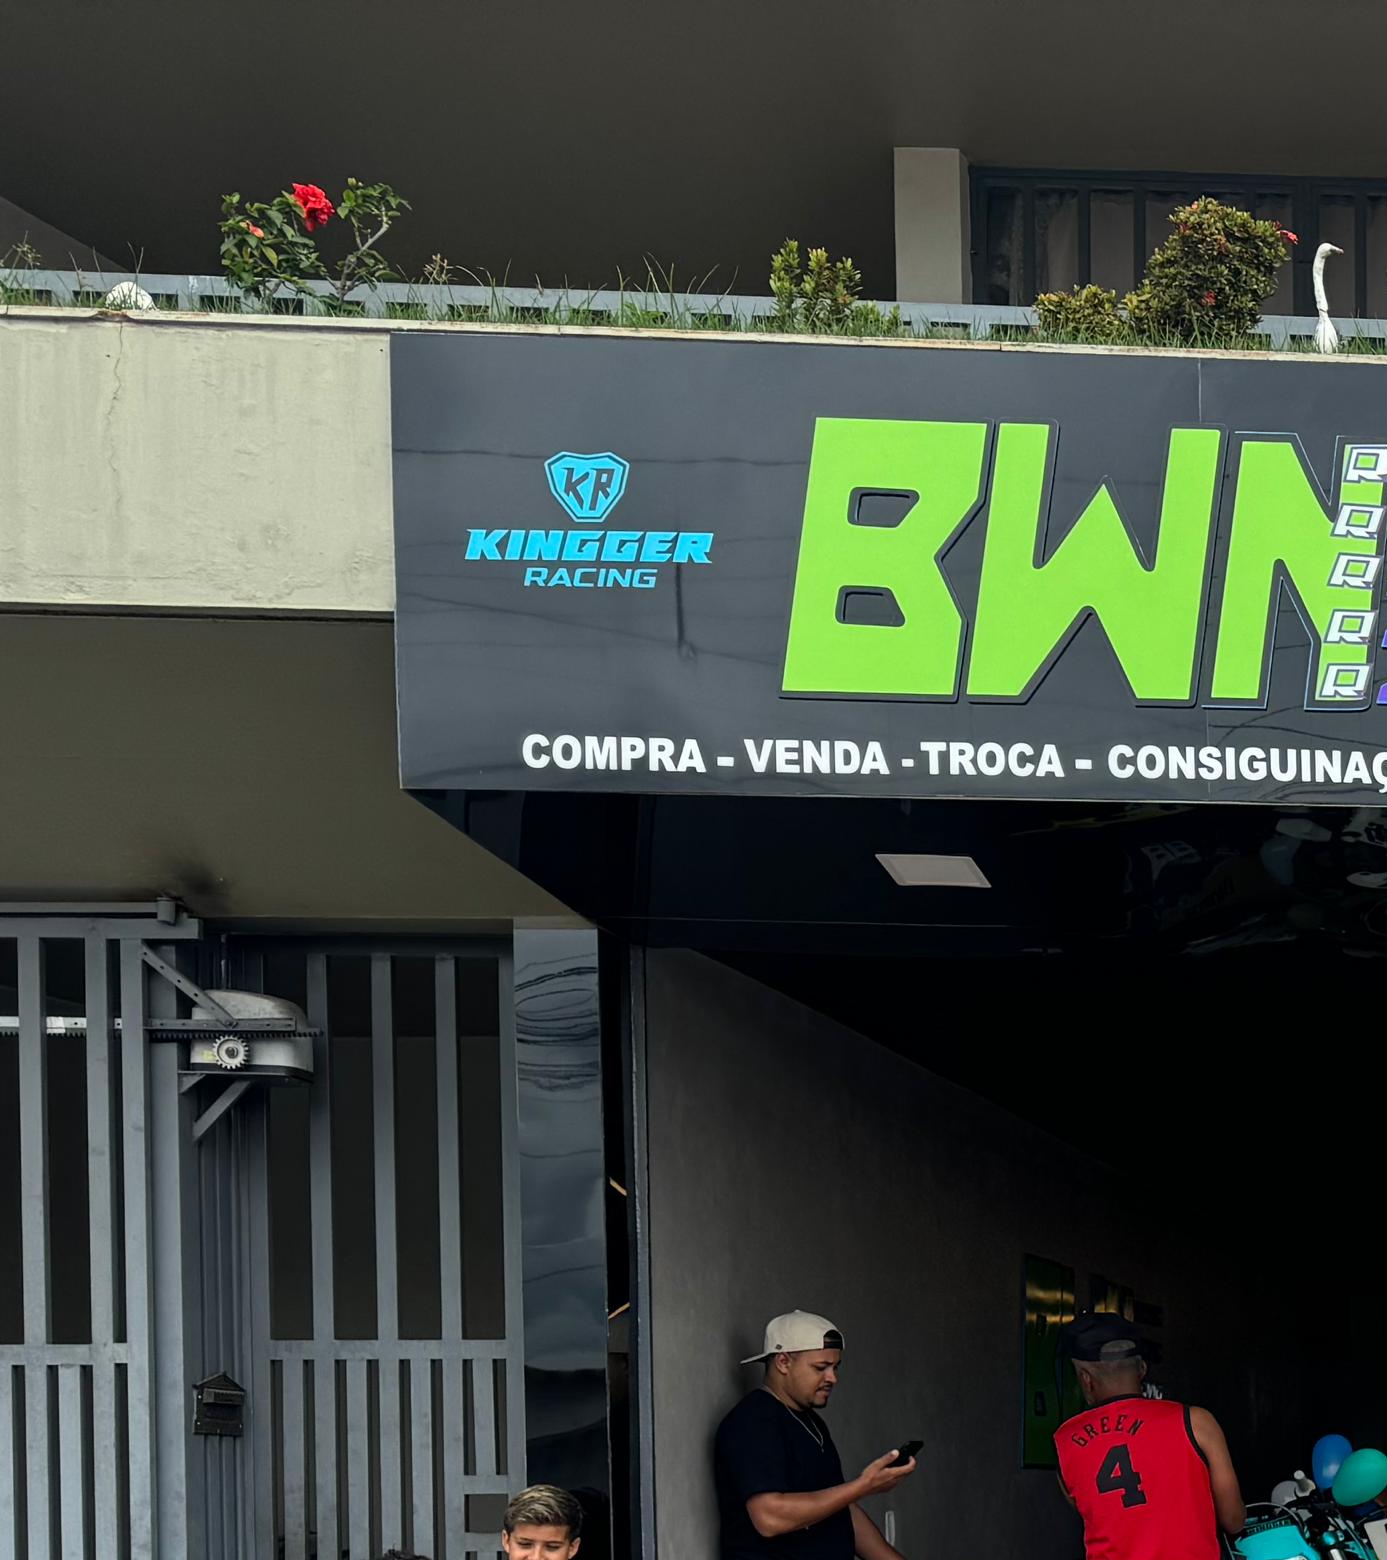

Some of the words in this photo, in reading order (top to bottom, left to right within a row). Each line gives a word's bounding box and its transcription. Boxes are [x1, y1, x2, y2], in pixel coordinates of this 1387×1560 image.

[465, 529, 714, 564] KINGGER
[781, 417, 1387, 702] BWN
[524, 567, 657, 589] RACING
[522, 733, 706, 773] COMPRA
[743, 738, 889, 775] VENDA
[920, 741, 1065, 778] TROCA
[1072, 1415, 1144, 1447] GREEN
[1096, 1443, 1148, 1509] 4
